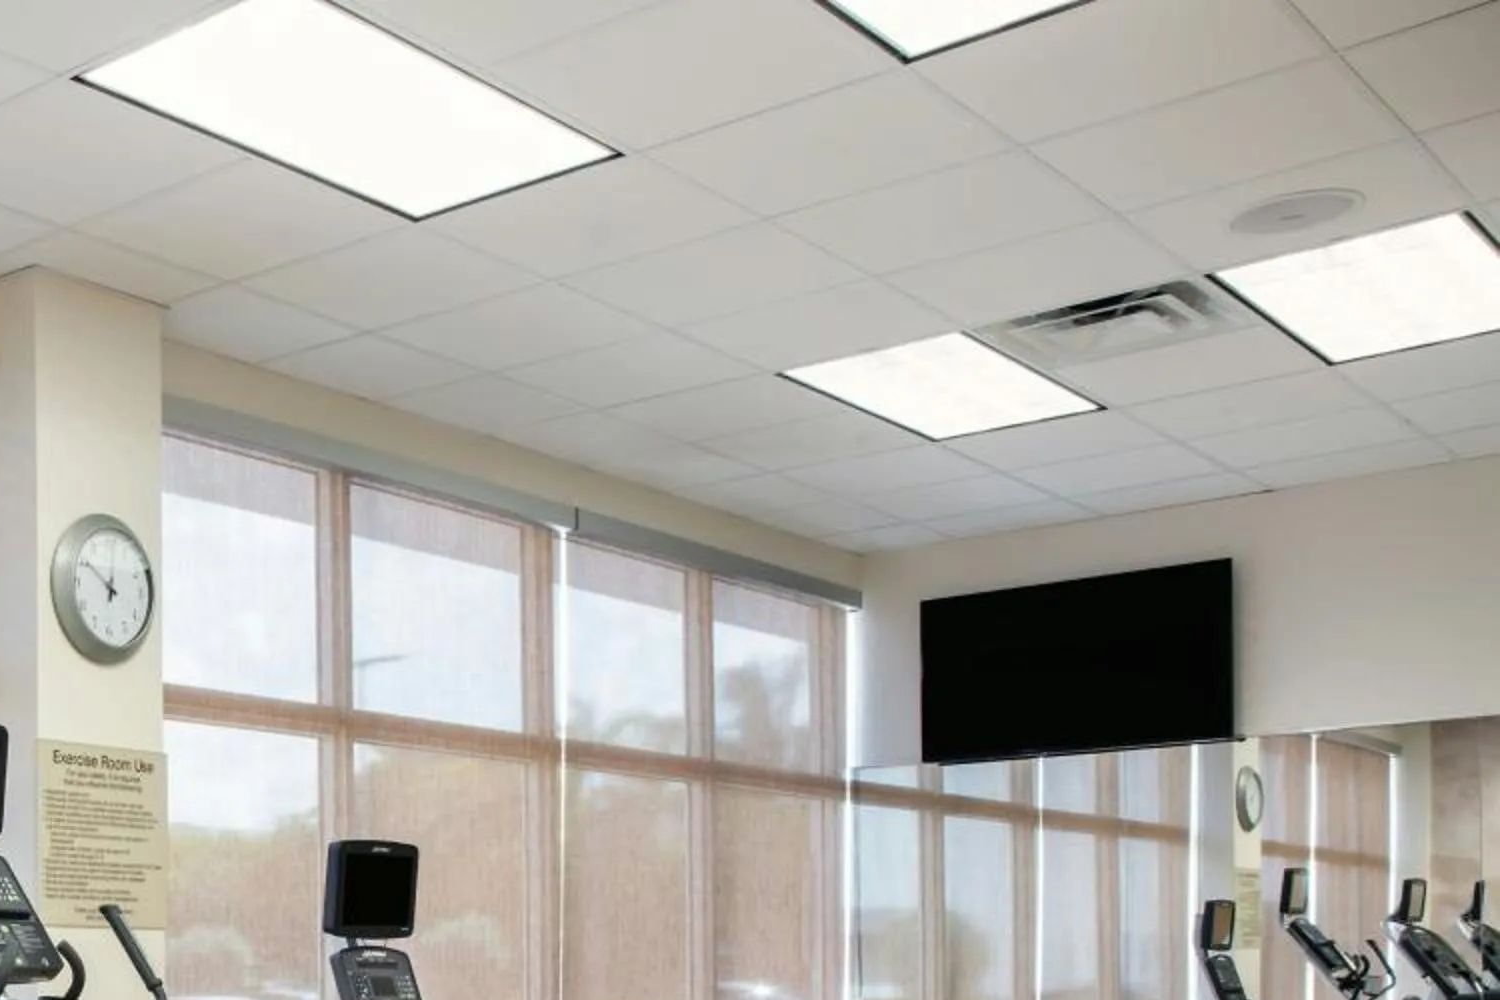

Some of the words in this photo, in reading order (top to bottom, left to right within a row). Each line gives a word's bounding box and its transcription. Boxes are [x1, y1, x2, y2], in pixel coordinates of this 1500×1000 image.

[51, 748, 99, 769] Exercise
[100, 754, 133, 772] Room
[134, 759, 155, 774] Use
